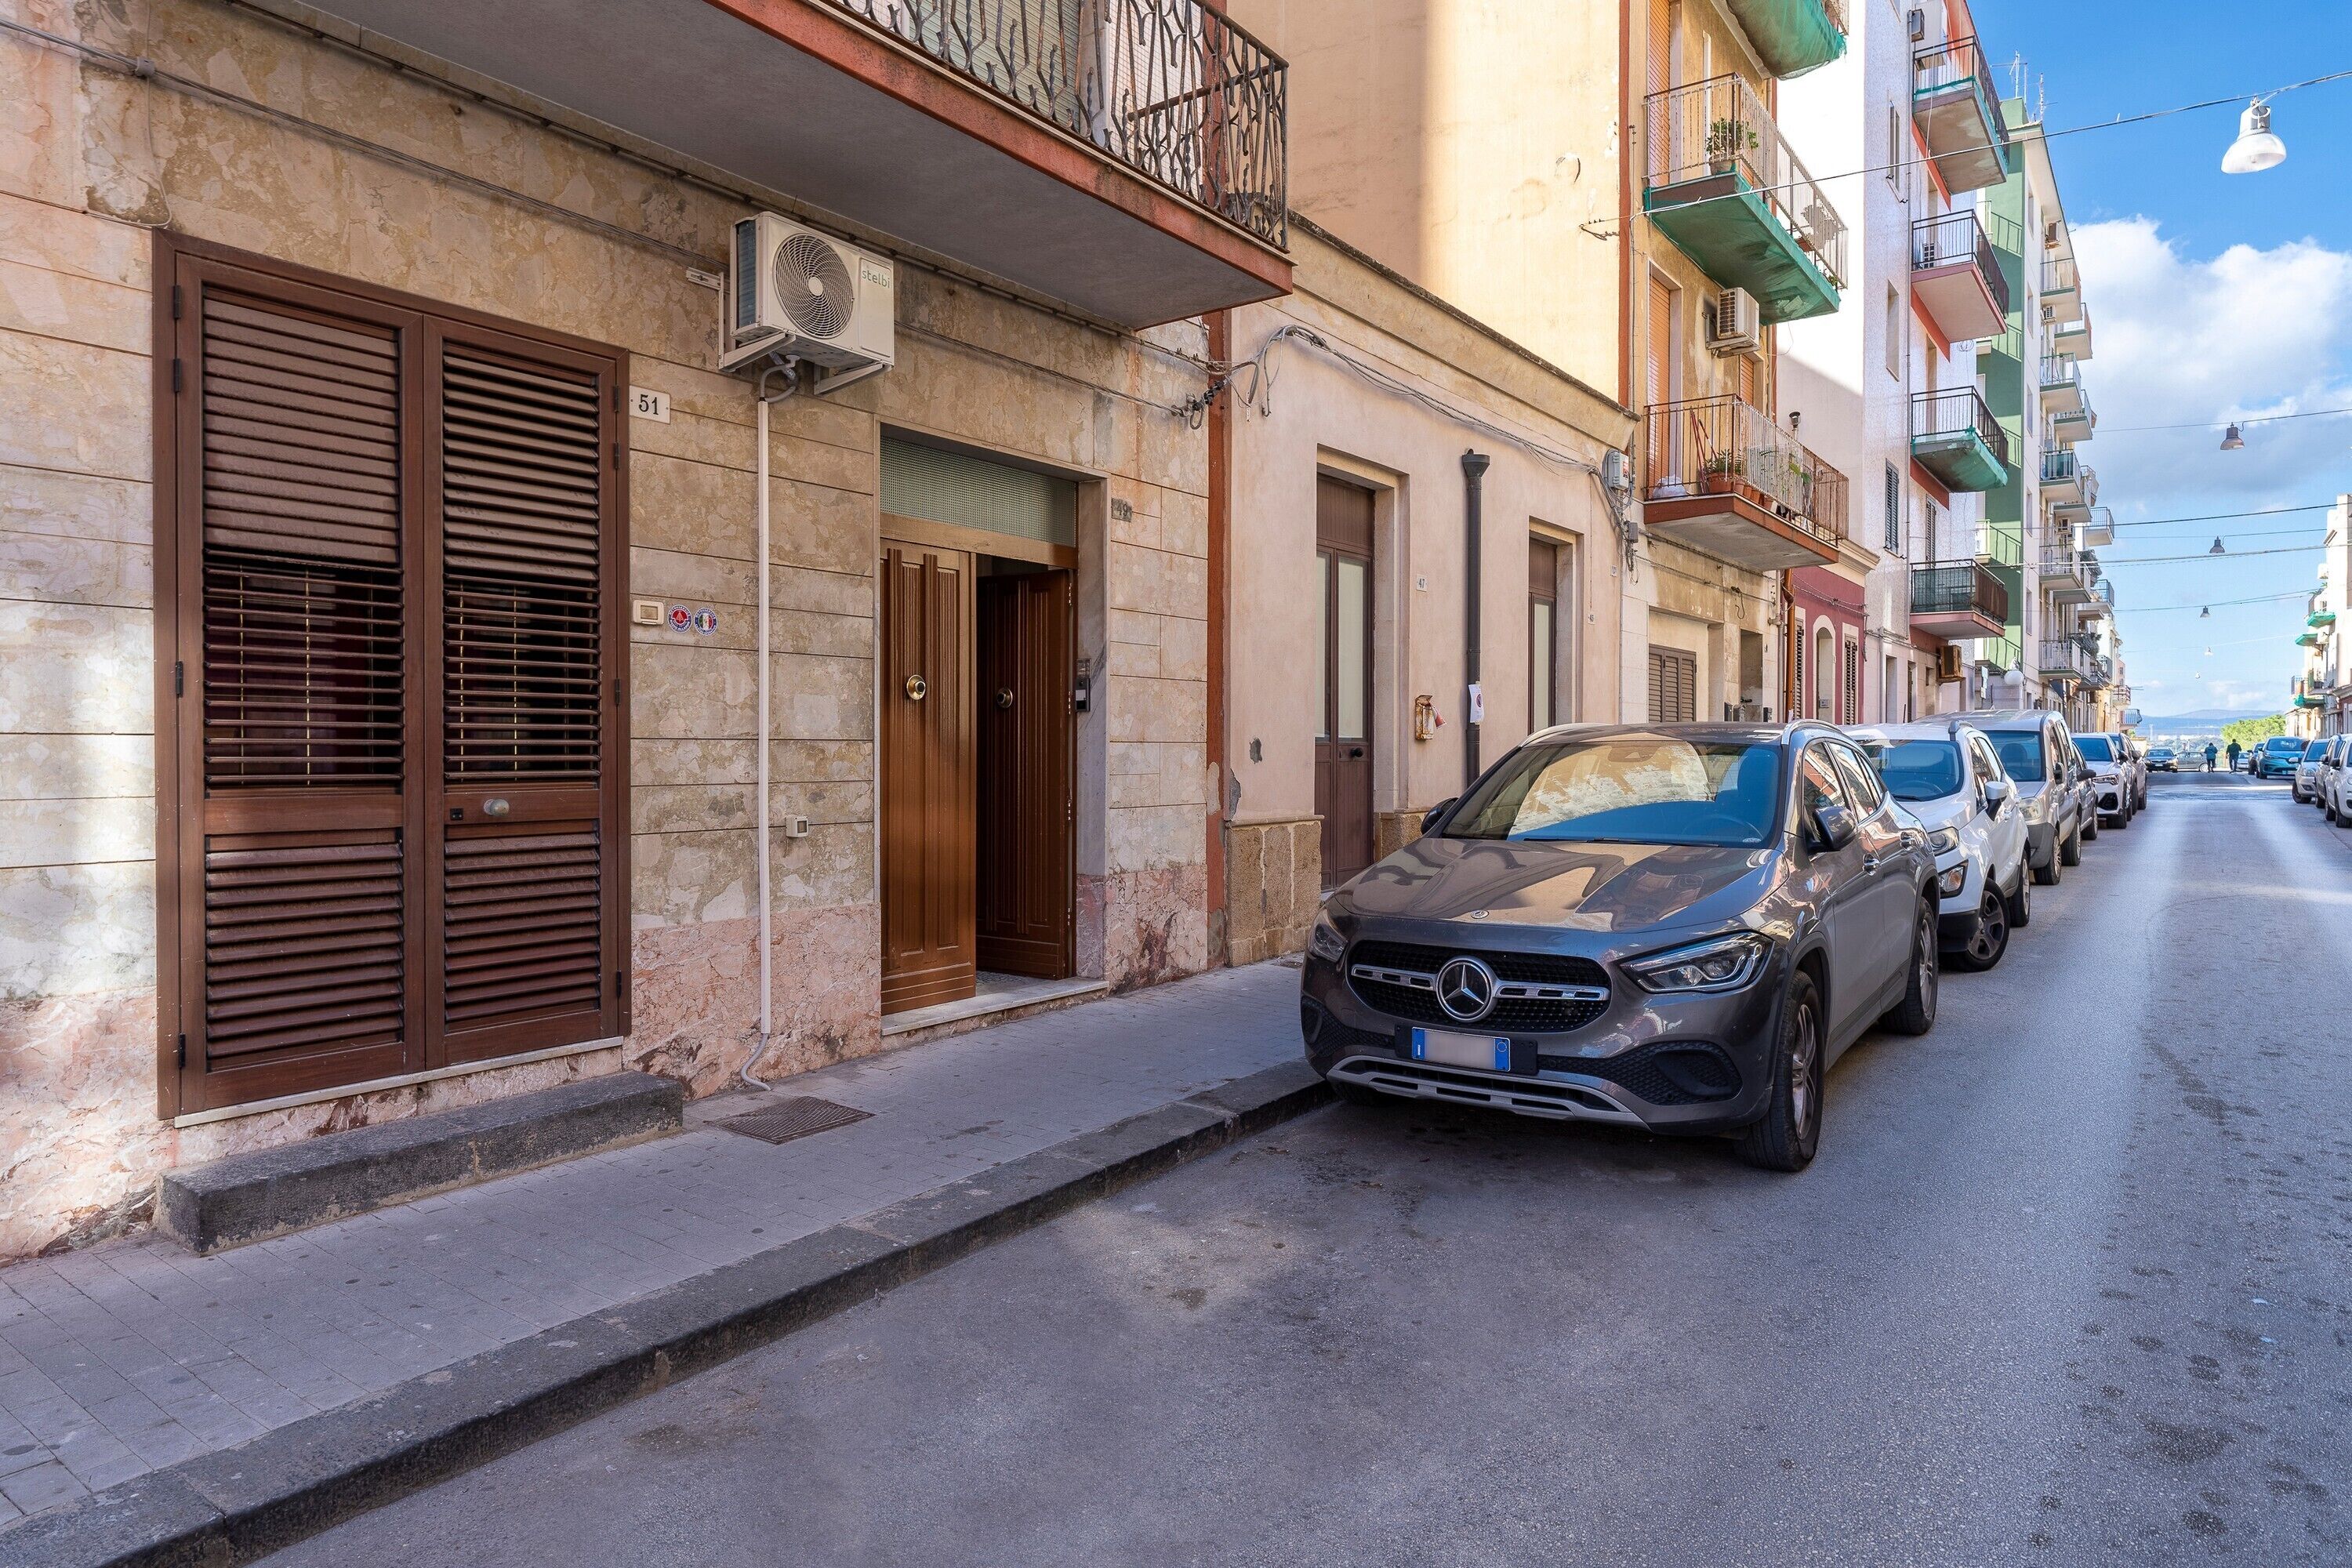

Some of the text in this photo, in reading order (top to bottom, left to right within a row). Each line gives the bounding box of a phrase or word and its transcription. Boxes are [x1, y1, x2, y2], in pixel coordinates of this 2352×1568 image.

[862, 270, 890, 289] stelbi
[638, 394, 659, 416] 51
[1116, 503, 1128, 517] 49
[1418, 578, 1425, 589] 47
